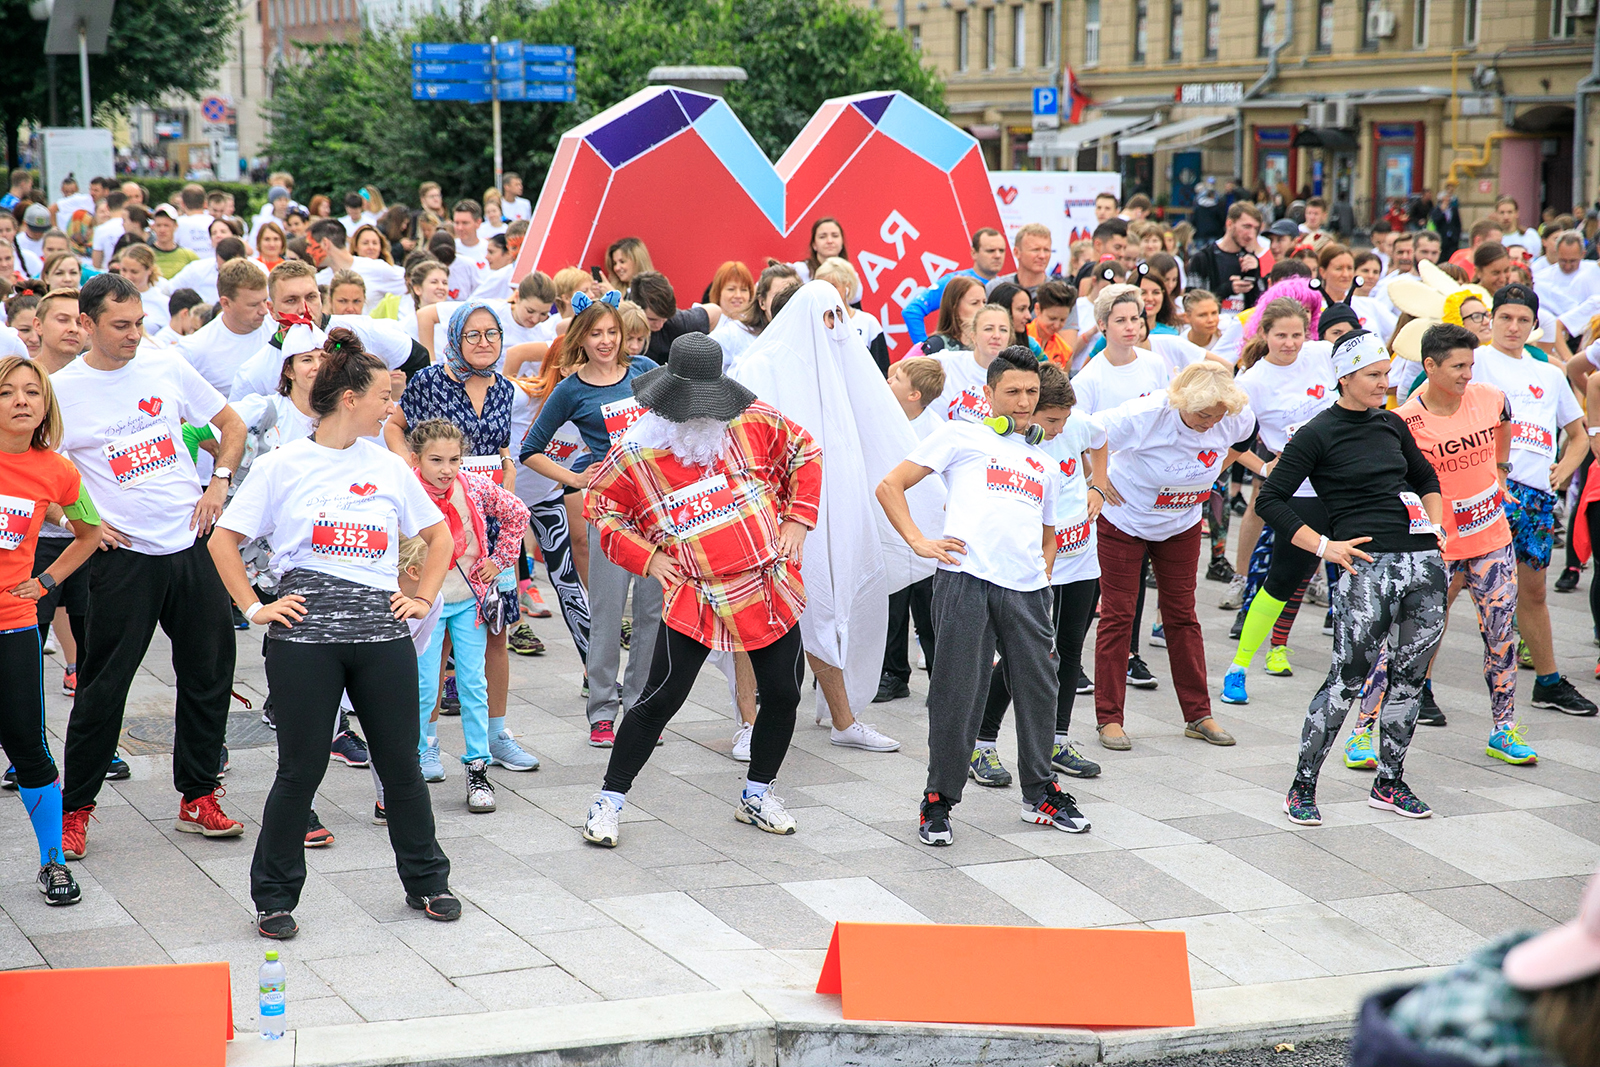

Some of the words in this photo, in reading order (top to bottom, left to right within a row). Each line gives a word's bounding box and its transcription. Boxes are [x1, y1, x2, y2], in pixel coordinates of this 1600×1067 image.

[1520, 425, 1545, 442] 396
[127, 444, 162, 468] 354
[1008, 474, 1027, 489] 47
[689, 496, 713, 516] 36
[1169, 494, 1198, 505] 449
[1470, 500, 1496, 521] 254
[332, 528, 369, 548] 352
[1061, 526, 1085, 547] 187
